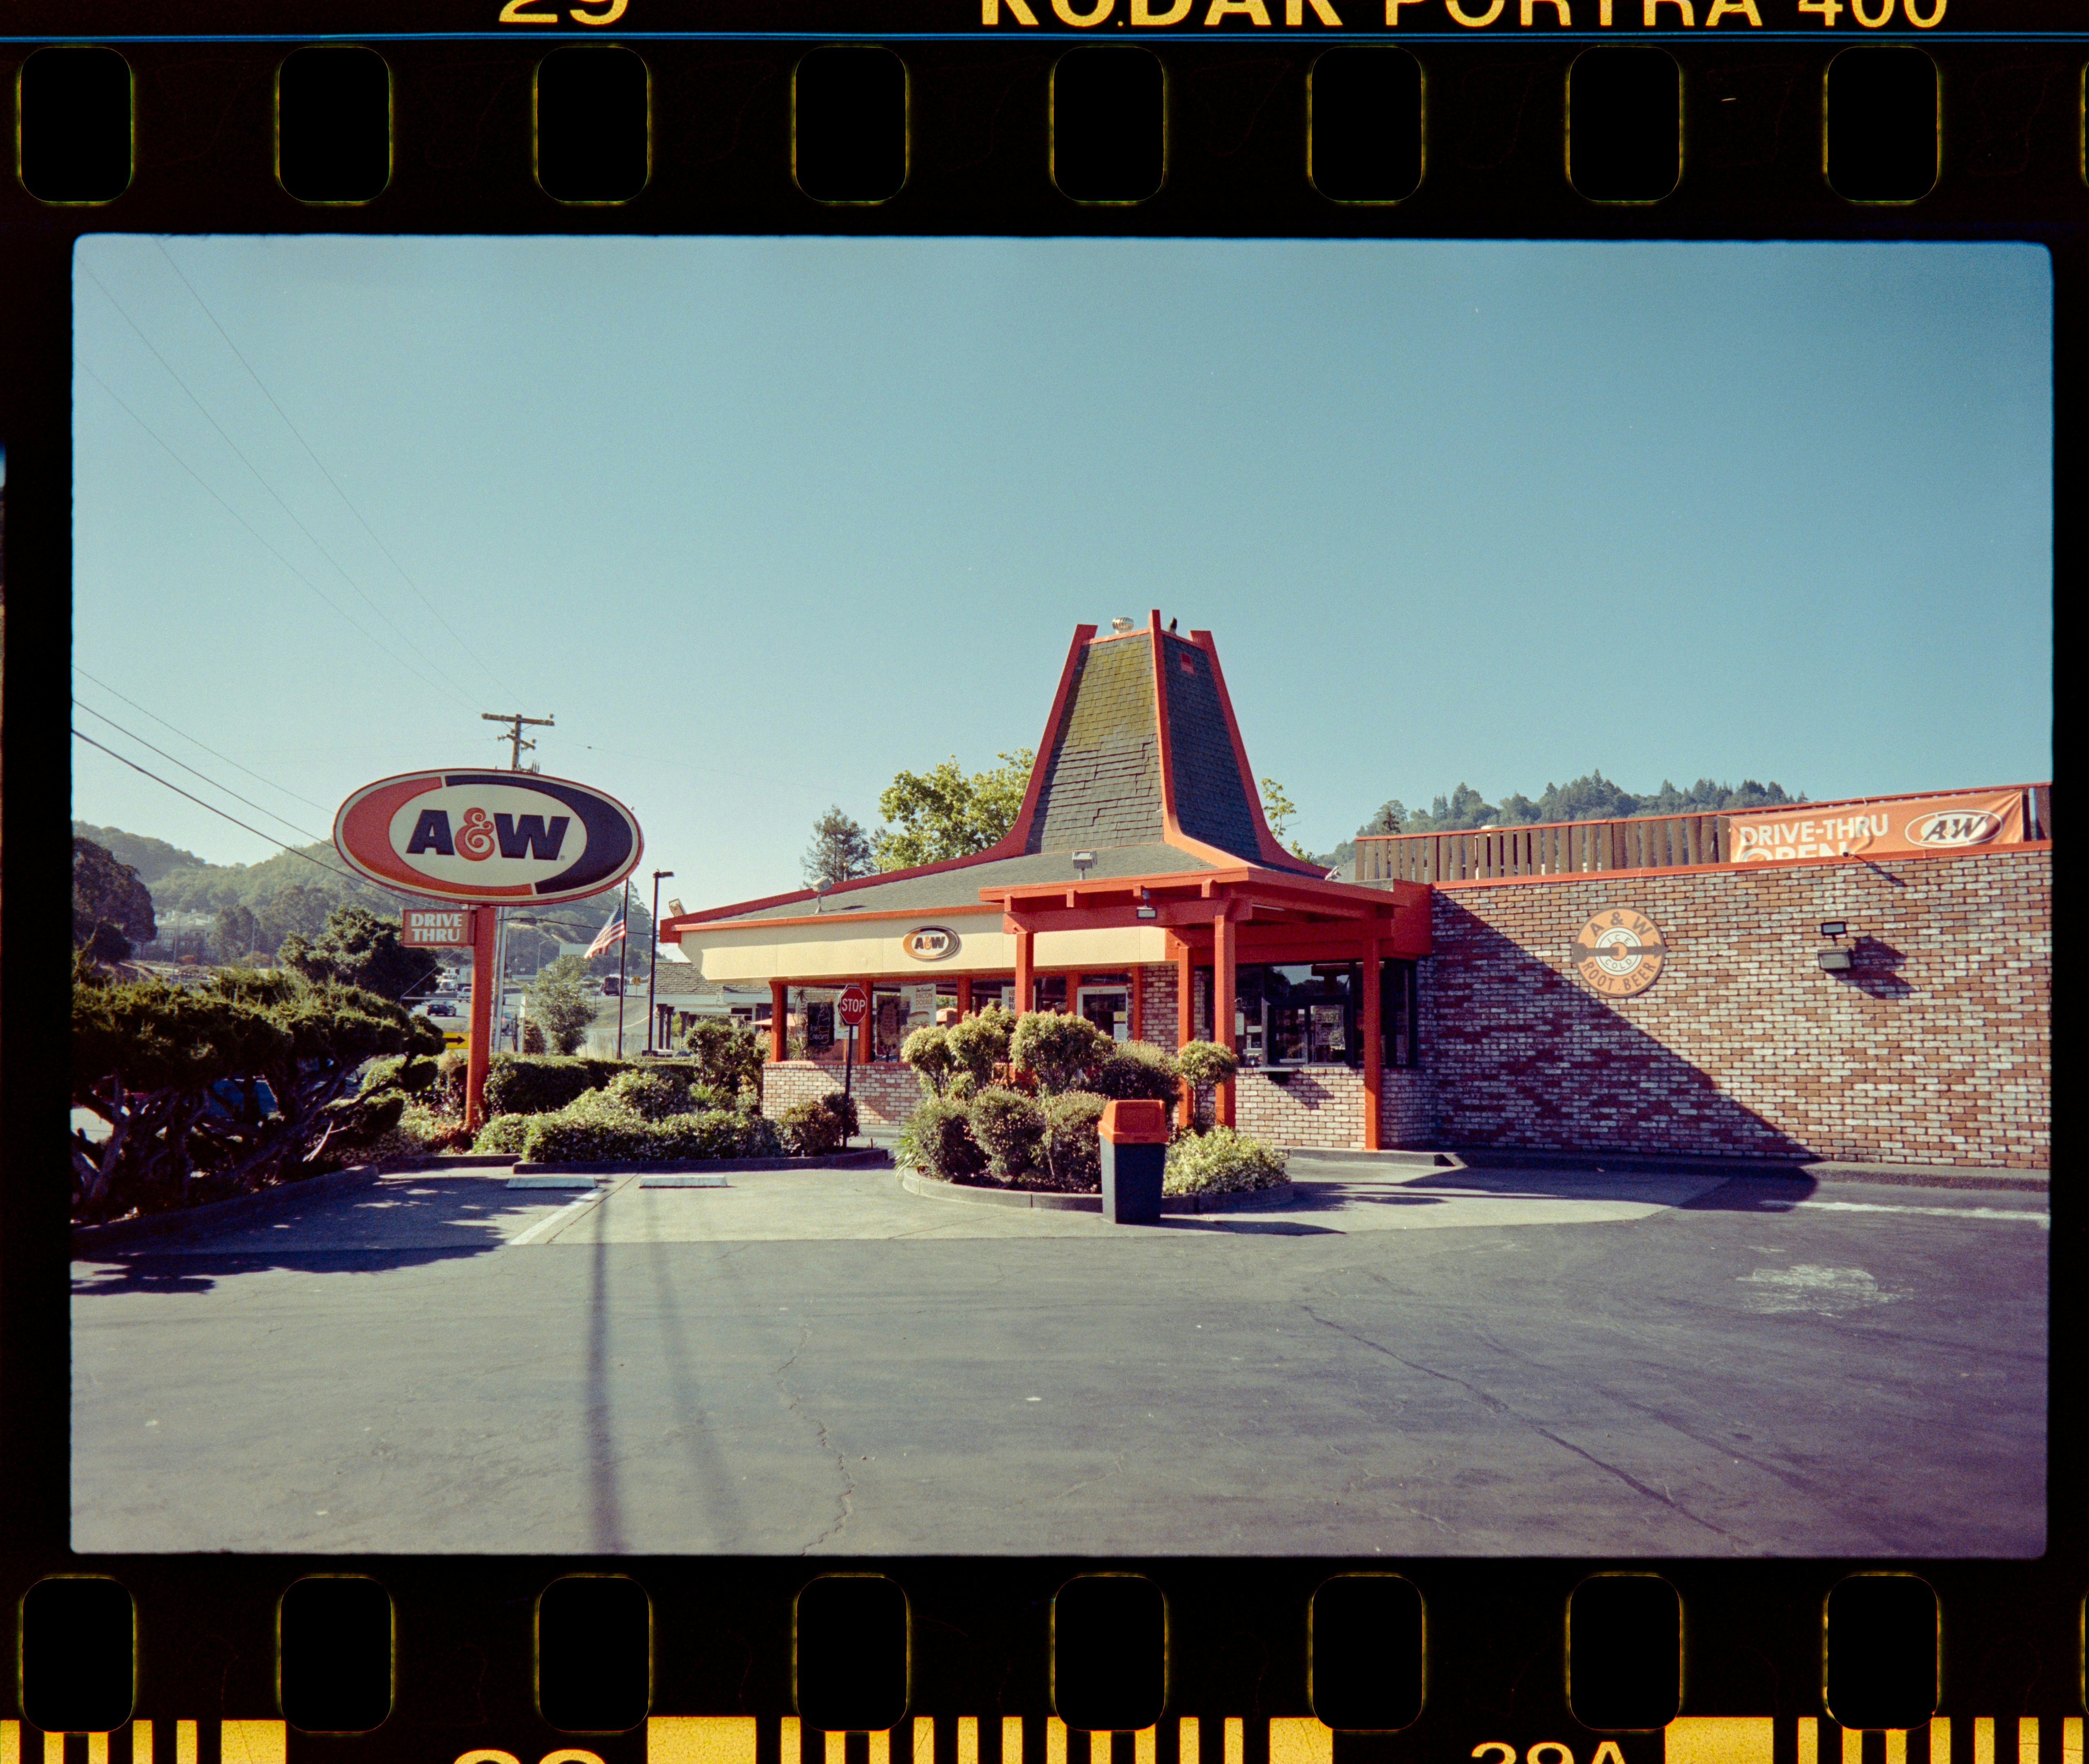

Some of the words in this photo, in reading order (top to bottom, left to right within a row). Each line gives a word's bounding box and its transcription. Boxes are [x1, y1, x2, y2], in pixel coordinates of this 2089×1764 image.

[406, 807, 570, 861] A&W
[1740, 814, 1888, 846] DRIVE-THRU
[1922, 816, 1989, 842] A&W
[411, 913, 463, 927] DRIVE
[412, 929, 460, 942] THRU
[1607, 934, 1631, 944] ICE
[914, 936, 945, 950] A&W
[1605, 959, 1632, 969] COLD
[1583, 962, 1615, 990] ROOT
[1623, 962, 1656, 991] BEER
[842, 998, 866, 1012] STOP
